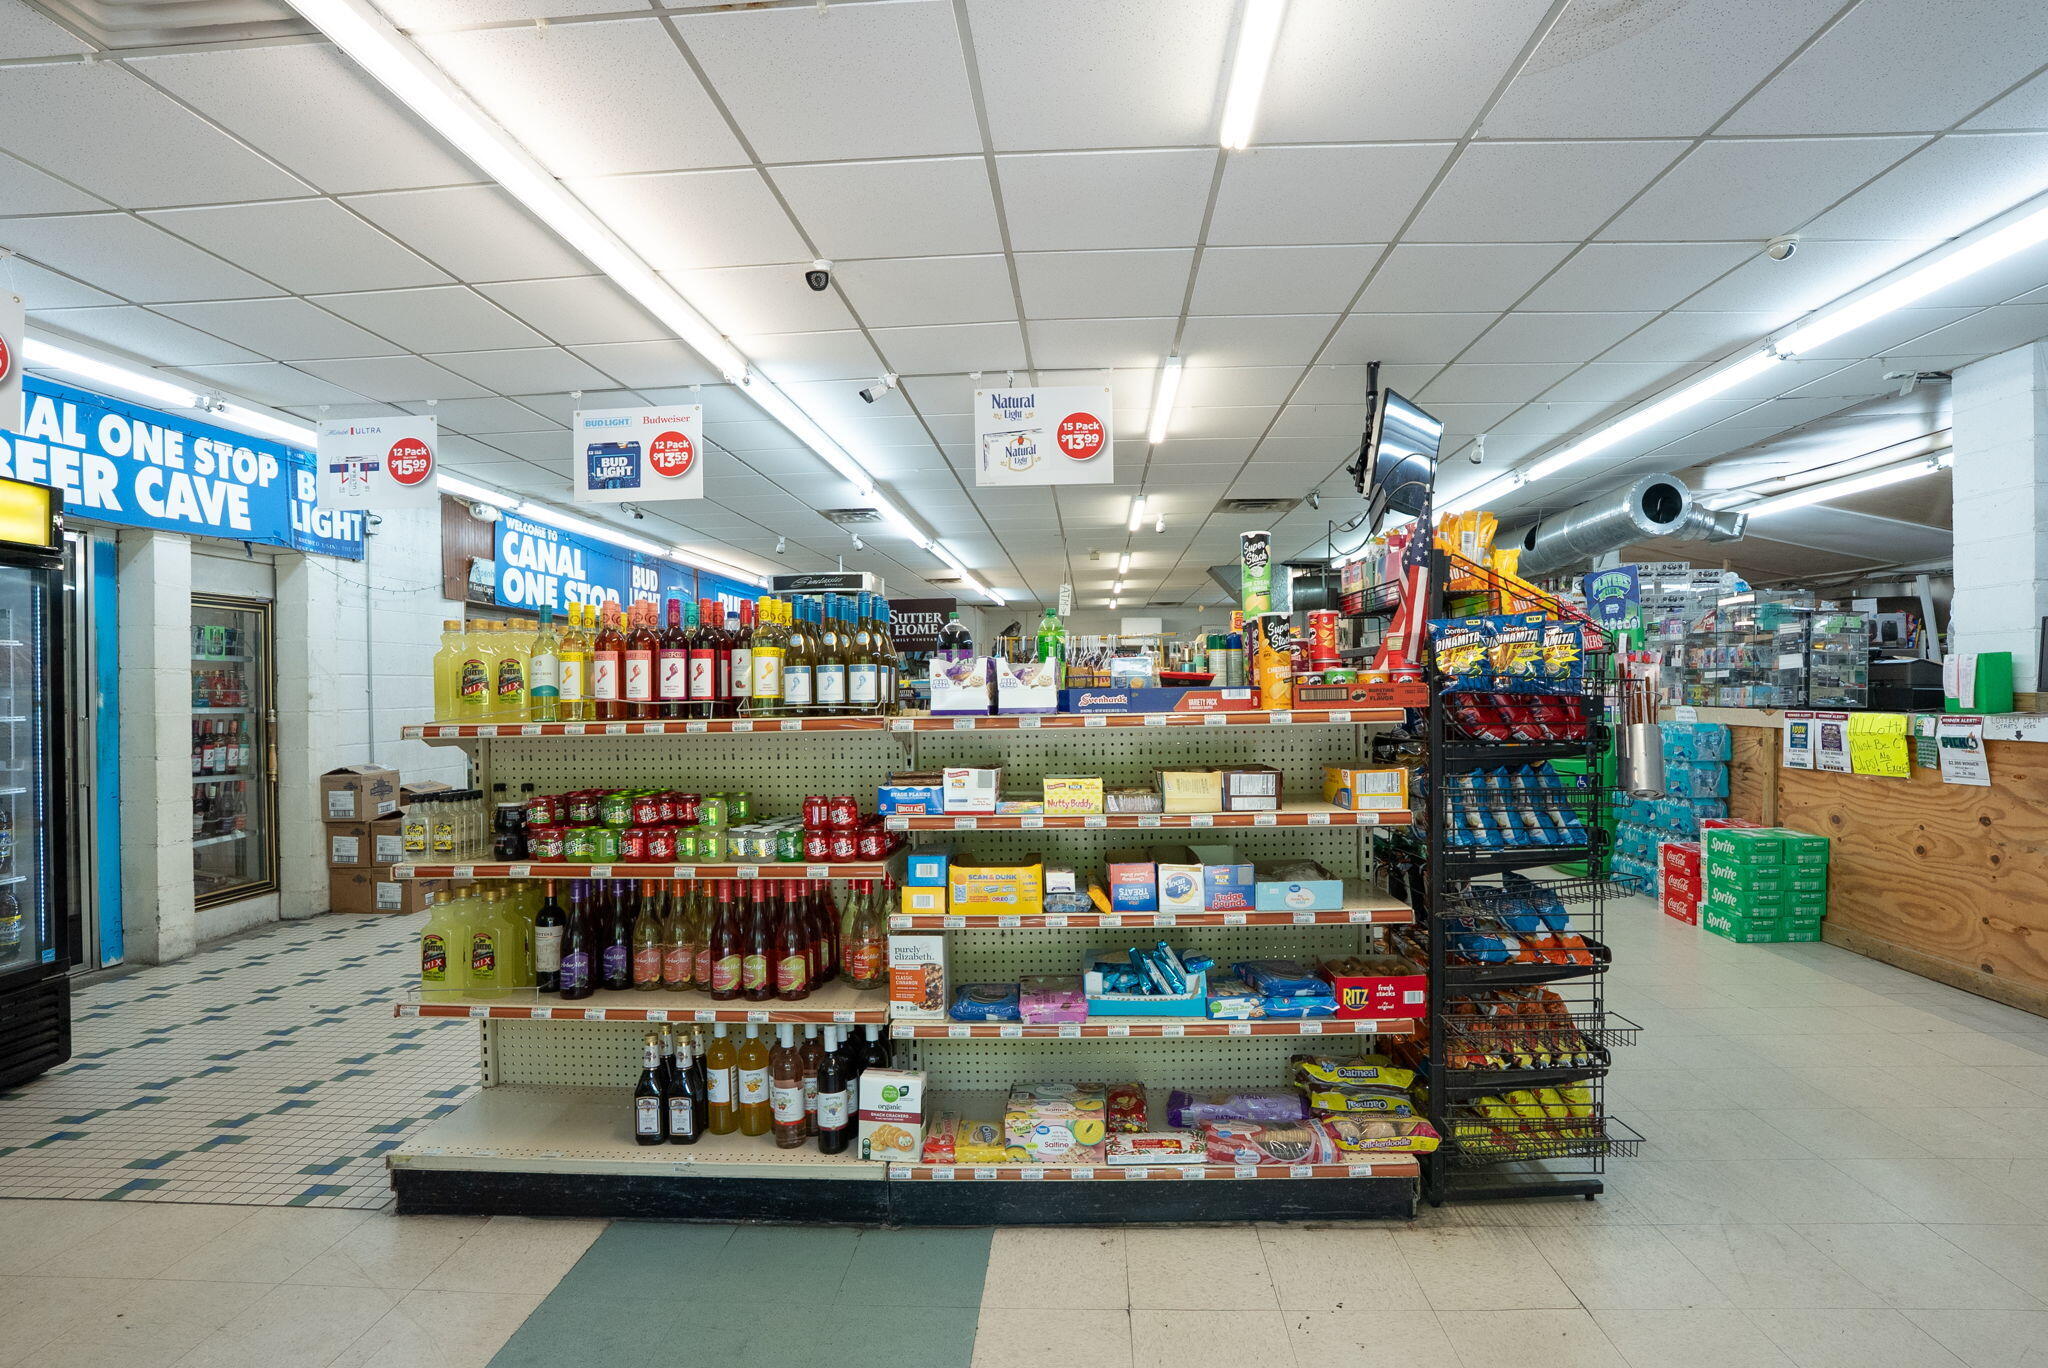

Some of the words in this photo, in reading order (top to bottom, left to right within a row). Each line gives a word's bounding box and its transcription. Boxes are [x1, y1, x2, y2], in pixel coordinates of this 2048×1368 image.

[992, 394, 1034, 409] Natural
[643, 415, 690, 425] Budweiser
[1004, 410, 1022, 421] Light
[585, 419, 603, 428] BUD
[605, 418, 629, 427] LIGHT
[1076, 421, 1099, 430] Pack
[355, 427, 382, 435] ULTRA
[22, 391, 86, 449] AL
[99, 413, 184, 470] ONE
[194, 436, 279, 488] STOP
[667, 440, 689, 449] Pack
[405, 447, 427, 456] Pack
[1005, 444, 1036, 458] Natural
[601, 457, 628, 467] BUD
[1014, 456, 1027, 464] Light
[596, 466, 632, 477] LIGHT
[135, 464, 252, 530] CAVE
[291, 499, 362, 541] LIGHT
[505, 517, 545, 540] WELCOME
[546, 528, 558, 541] TO
[1243, 541, 1266, 554] Super
[503, 531, 586, 581] CANAL
[1246, 550, 1268, 565] Stack
[633, 565, 659, 591] BUD
[502, 567, 558, 606] ONE
[889, 610, 944, 624] SUTTER
[895, 624, 938, 636] HOME
[1435, 631, 1480, 652] DINAMITA
[464, 682, 485, 694] MIX
[500, 681, 520, 693] MIX
[1078, 693, 1128, 707] Svenhard's
[1047, 799, 1070, 809] Nutty
[1071, 799, 1093, 809] Buddy
[640, 807, 652, 817] BIG
[832, 808, 843, 817] BIG
[649, 841, 660, 849] BIG
[809, 839, 820, 848] BIG
[834, 840, 846, 848] BIG
[860, 839, 871, 847] BIG
[1711, 837, 1735, 854] Sprite
[1667, 850, 1686, 867] Coca-Cola
[1711, 862, 1737, 881] Sprite
[1668, 874, 1689, 891] Coca-Cola
[1119, 887, 1149, 896] TREATS
[1177, 883, 1190, 894] Pie
[1215, 893, 1244, 903] Fudge
[1712, 887, 1737, 907] Sprite
[1212, 899, 1247, 909] Rounds
[1667, 897, 1688, 915] Coca-Cola
[1706, 912, 1732, 932] Sprite
[894, 946, 920, 954] purely
[894, 952, 934, 961] elizabeth.
[423, 958, 442, 970] MIX
[473, 957, 491, 968] MIX
[1343, 987, 1369, 1006] RITZ
[1376, 989, 1395, 997] stacks
[1338, 1068, 1378, 1078] Oatmeal
[1347, 1100, 1387, 1109] Oatmeal
[1360, 1139, 1411, 1149] Snickerdoodle
